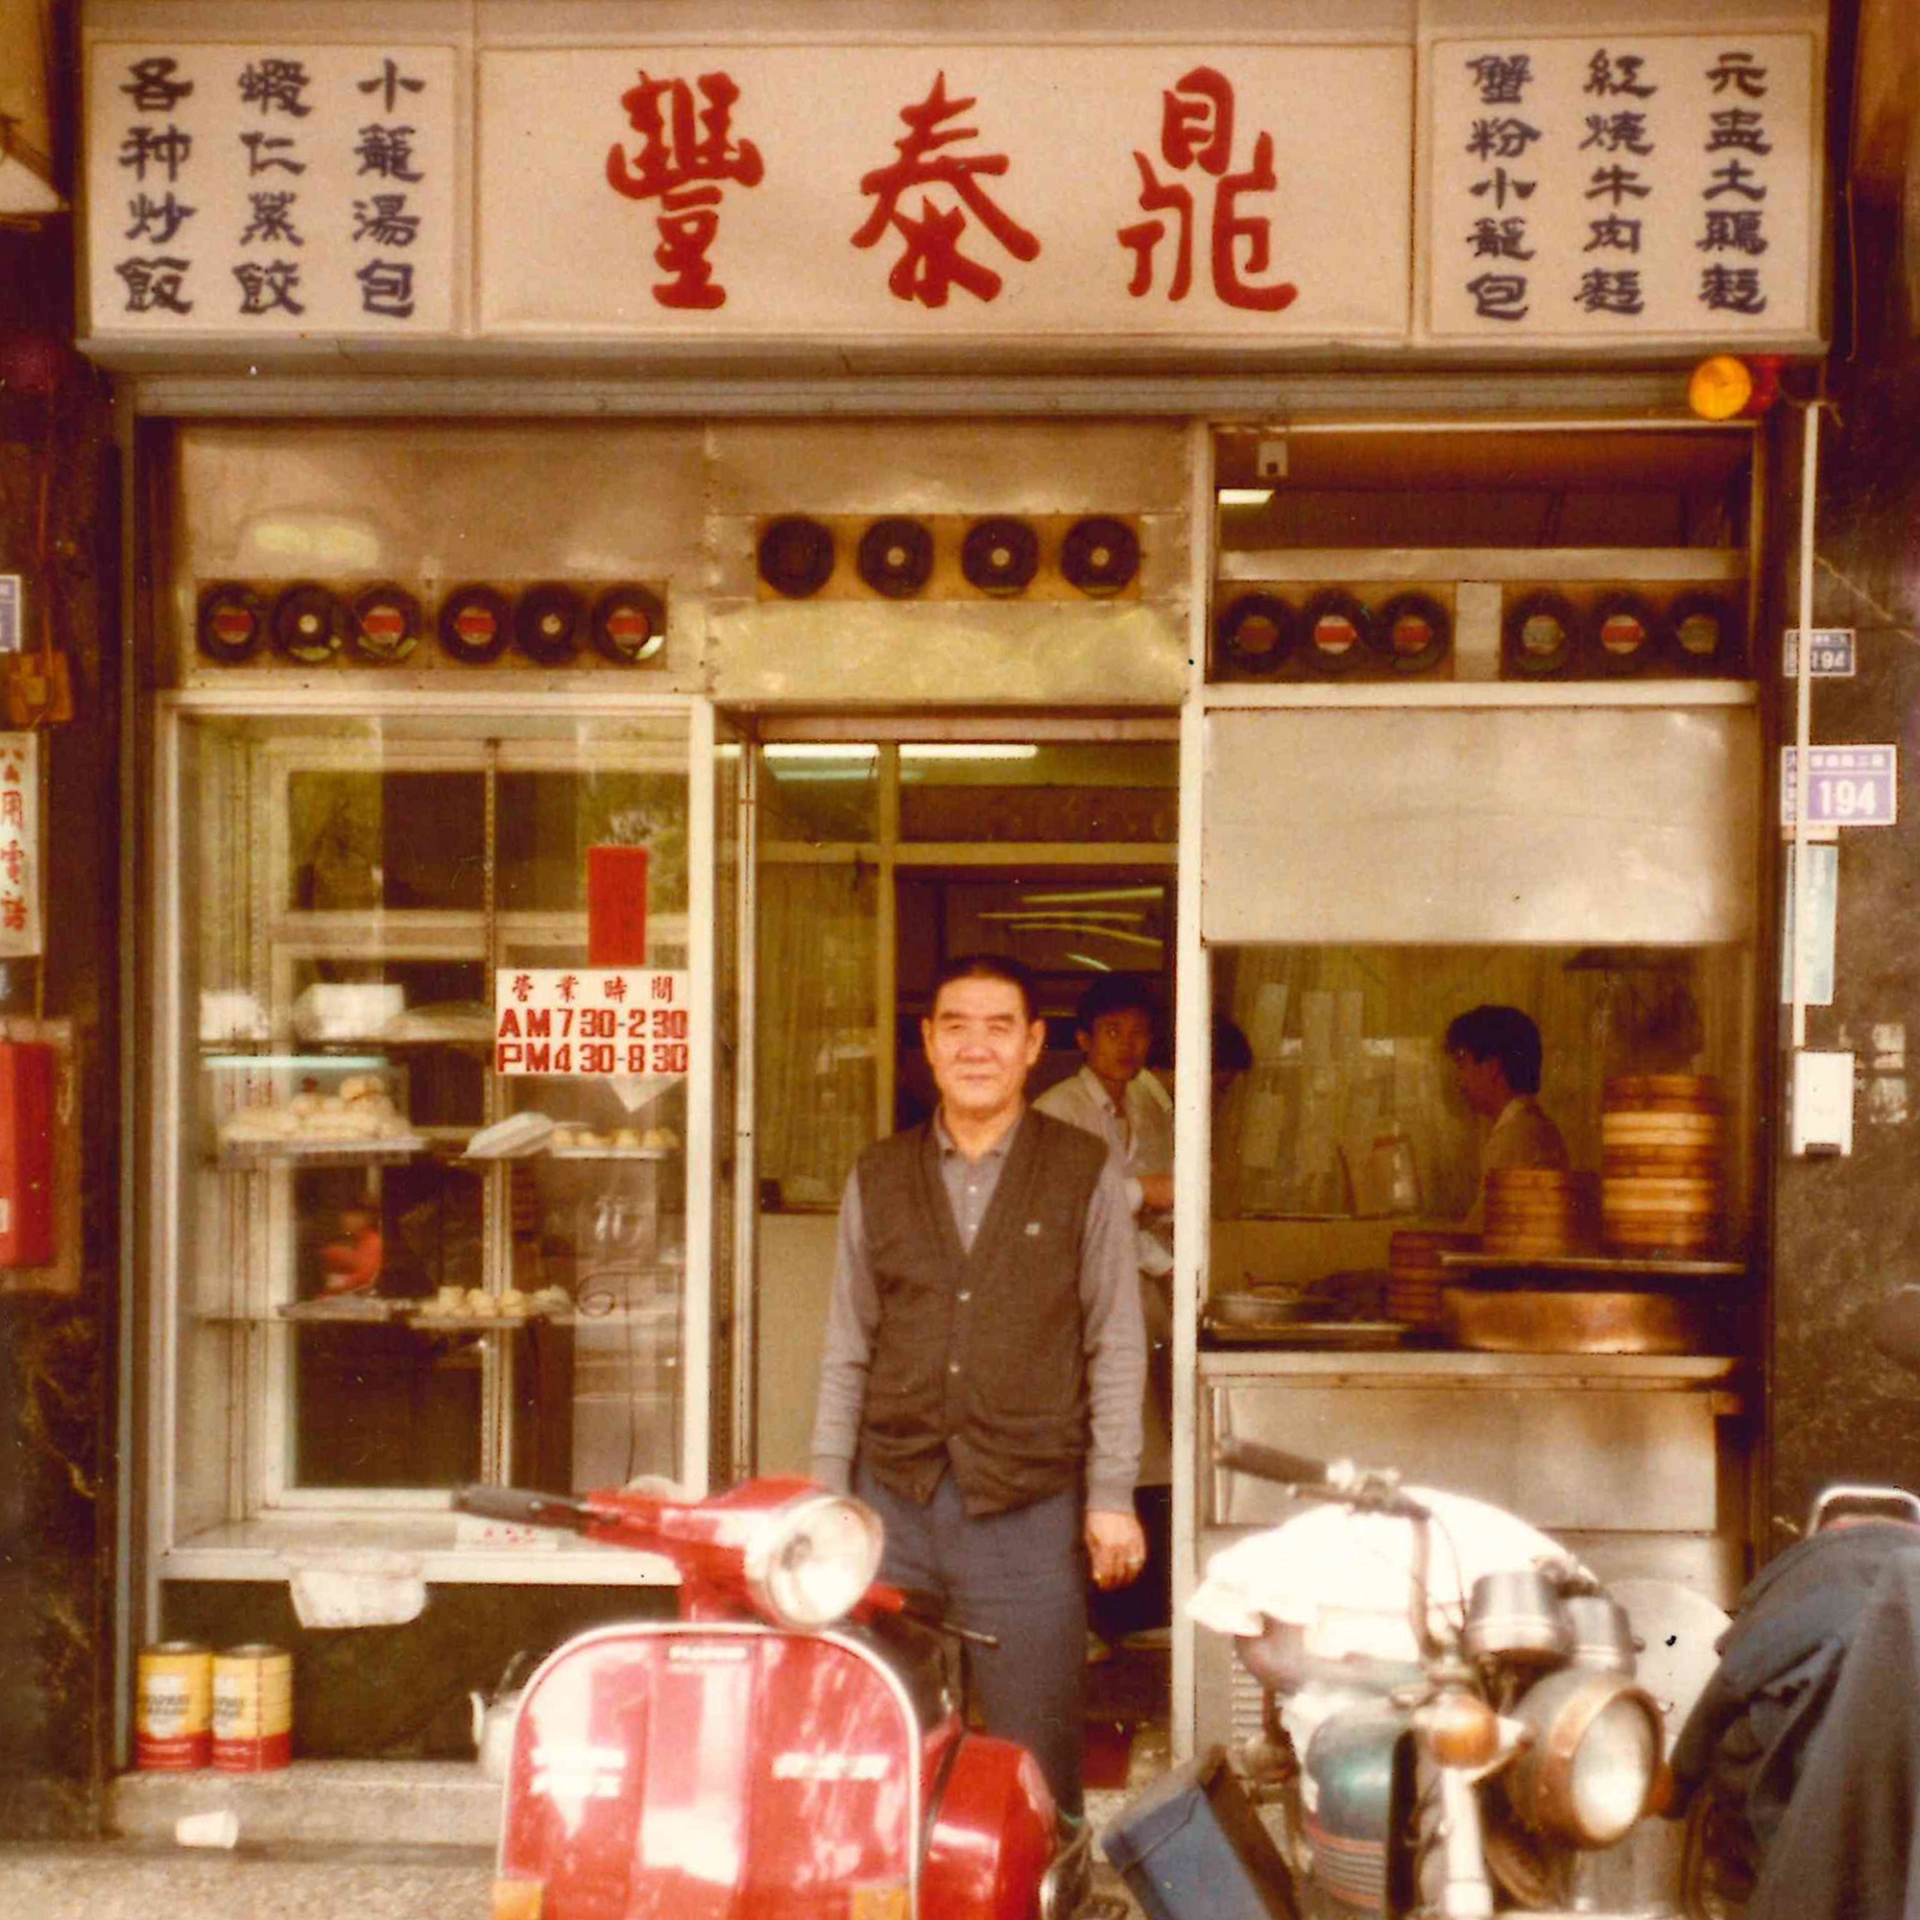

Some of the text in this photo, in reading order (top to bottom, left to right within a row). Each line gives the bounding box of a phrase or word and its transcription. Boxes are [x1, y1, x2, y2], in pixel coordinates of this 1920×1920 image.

[232, 58, 312, 315] 蝦仁蒸餃
[352, 58, 426, 319] 小籠湯包
[1465, 53, 1542, 321] 蟹粉小籠包
[1811, 650, 1846, 669] 194
[1818, 780, 1876, 816] 194
[512, 975, 674, 1003] 營業時間
